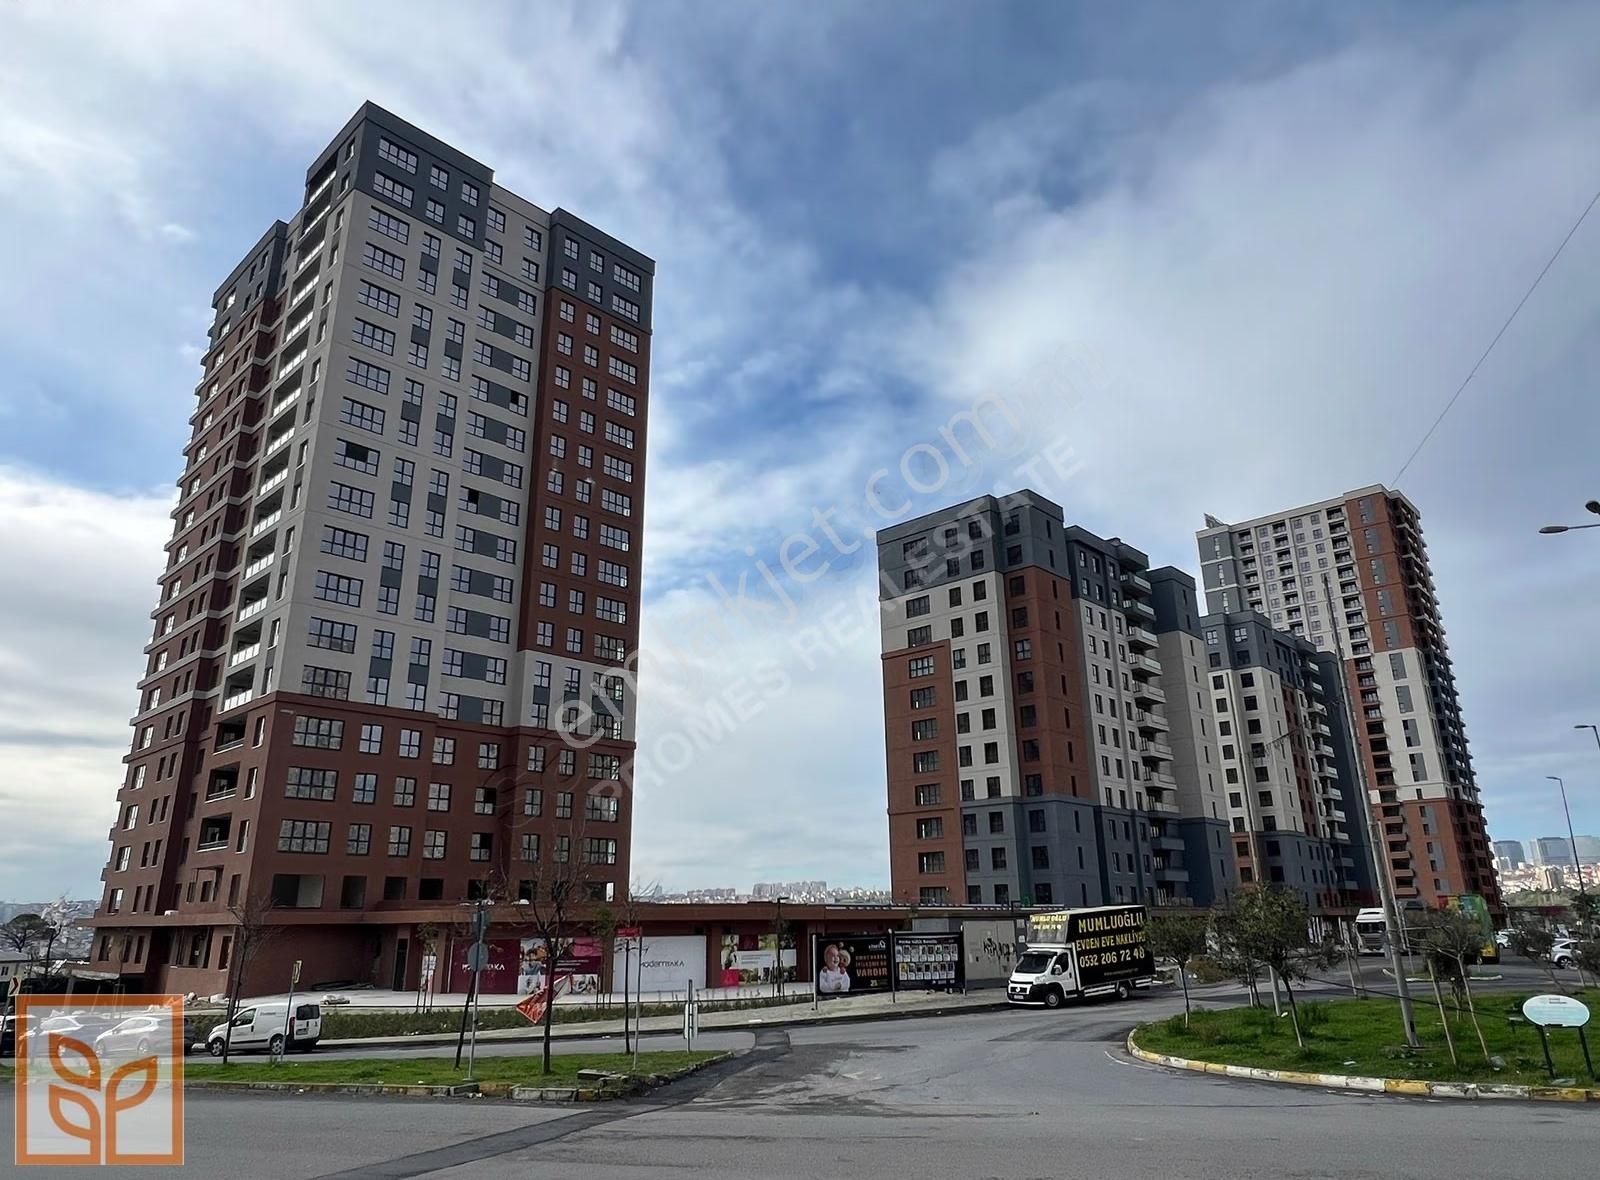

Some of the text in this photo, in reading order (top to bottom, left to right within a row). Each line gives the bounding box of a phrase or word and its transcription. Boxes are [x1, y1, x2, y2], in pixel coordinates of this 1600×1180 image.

[1078, 911, 1144, 933] MUMLUOĞLU
[1076, 937, 1100, 951] EVDEN
[1101, 935, 1115, 948] EVE
[1080, 955, 1099, 968] 0532
[1101, 952, 1118, 964] 206
[1120, 949, 1132, 962] 72
